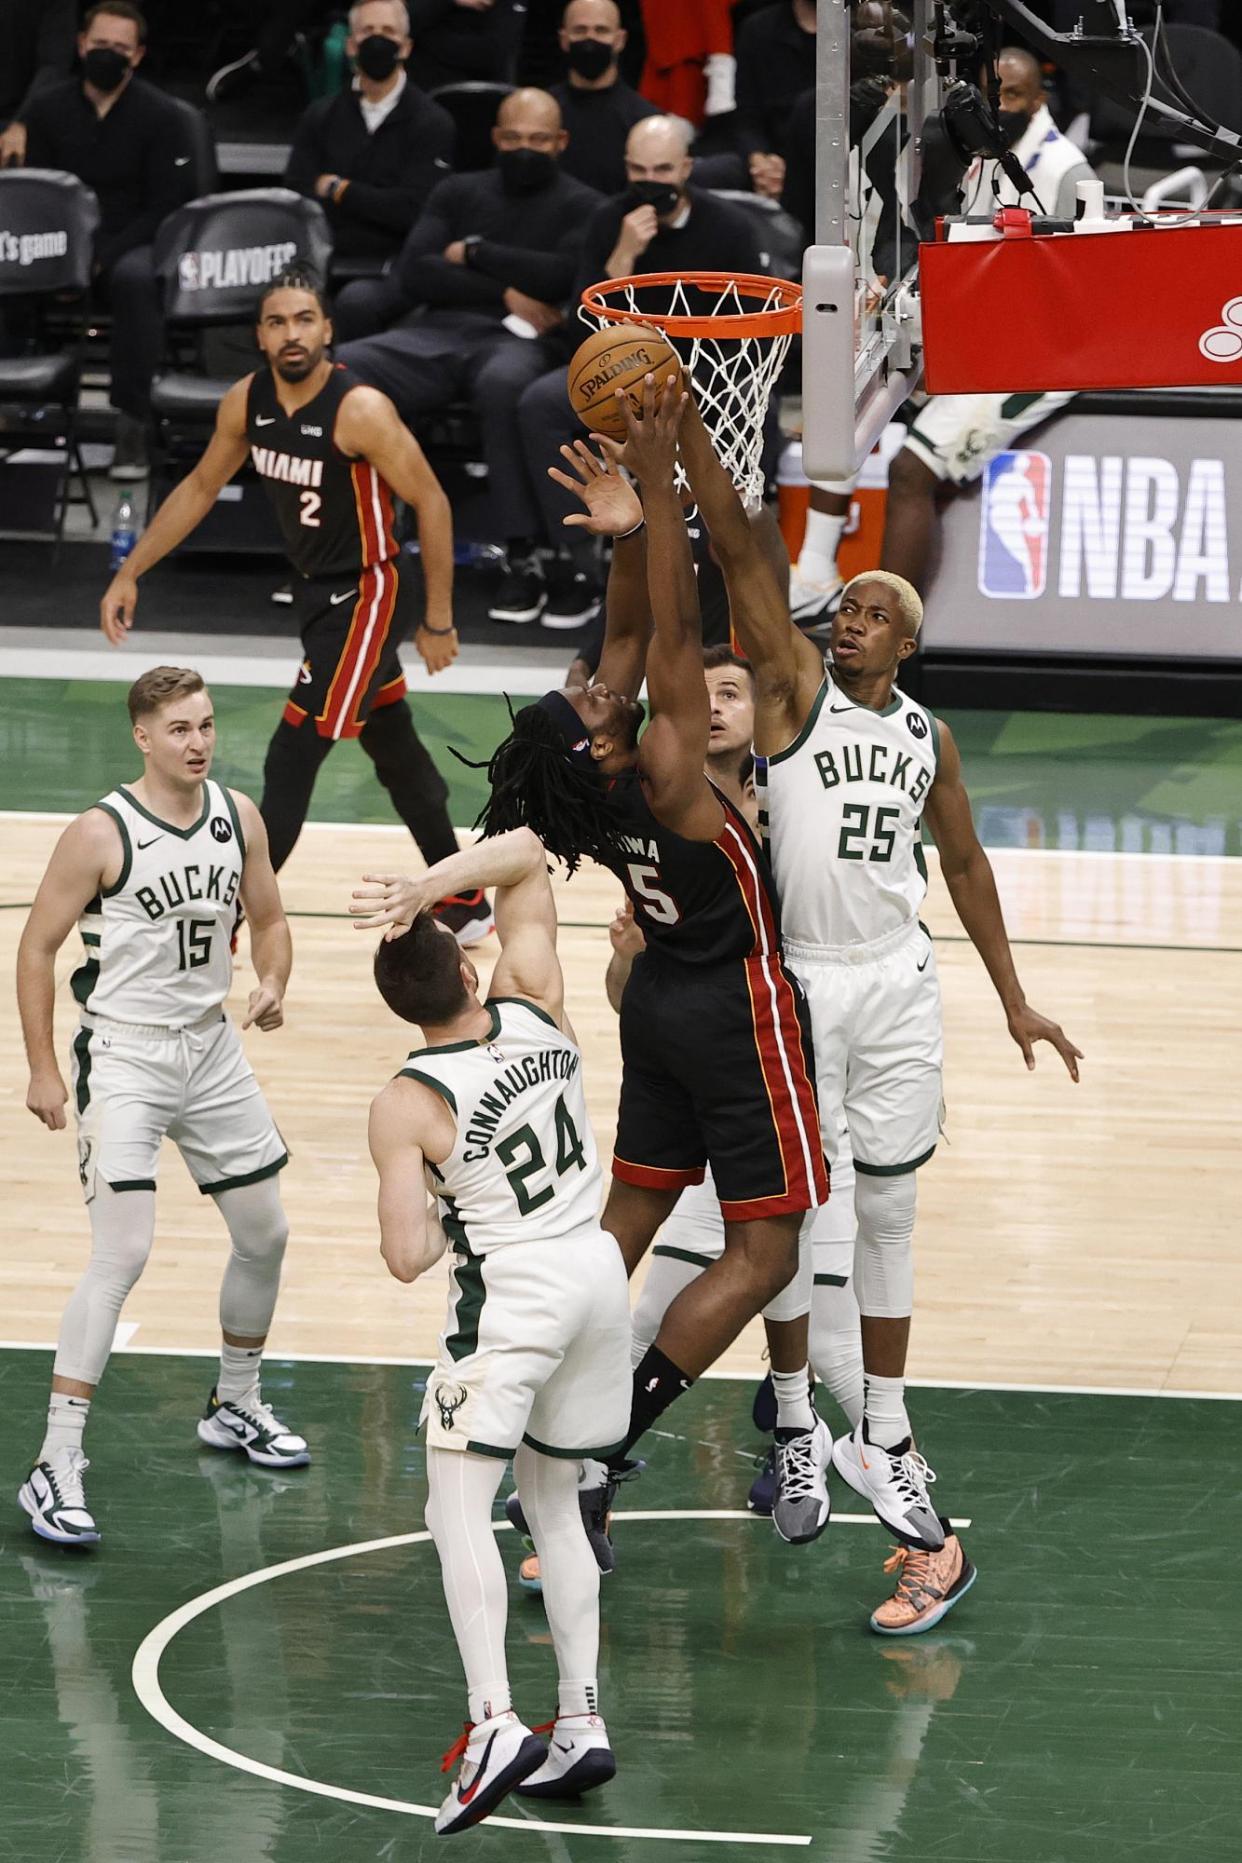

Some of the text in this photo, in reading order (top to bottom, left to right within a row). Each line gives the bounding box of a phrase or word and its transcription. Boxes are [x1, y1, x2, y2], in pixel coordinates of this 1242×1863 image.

[19, 231, 68, 266] game
[579, 348, 652, 403] SPALDING
[251, 444, 324, 488] MIAMI
[299, 490, 322, 528] 2
[1058, 454, 1231, 603] NBA
[813, 743, 931, 804] BUCKS
[837, 802, 900, 863] 25
[134, 863, 240, 921] BUCKS
[626, 863, 680, 926] 5
[176, 918, 217, 971] 15
[463, 1049, 579, 1164] CONNAUGHTON
[494, 1092, 588, 1217] 24
